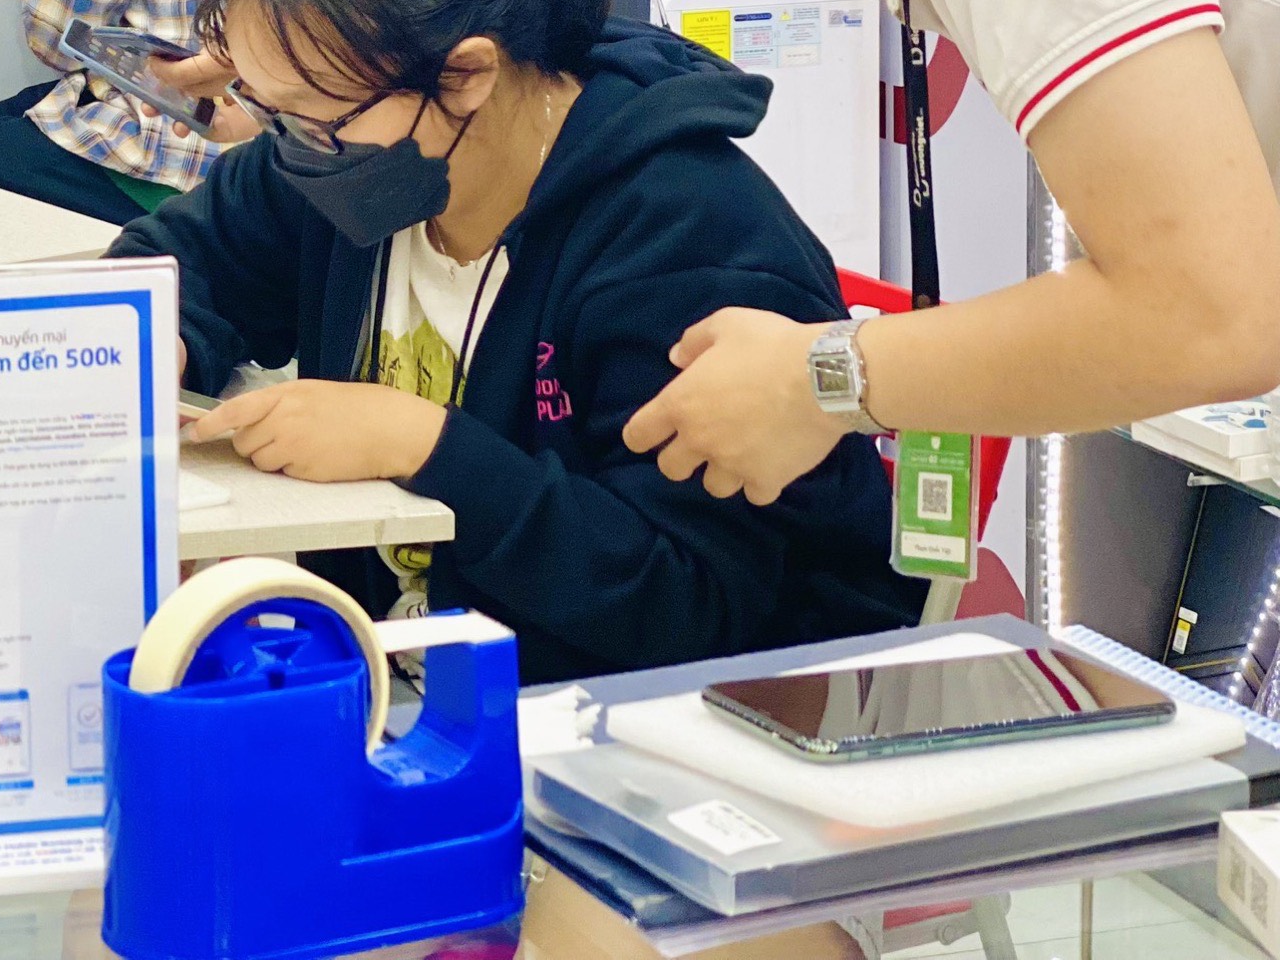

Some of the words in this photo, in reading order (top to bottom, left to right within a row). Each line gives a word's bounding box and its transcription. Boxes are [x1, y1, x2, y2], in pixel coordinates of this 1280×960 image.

[42, 328, 67, 346] mại
[17, 348, 59, 371] đến
[66, 346, 122, 369] 500k
